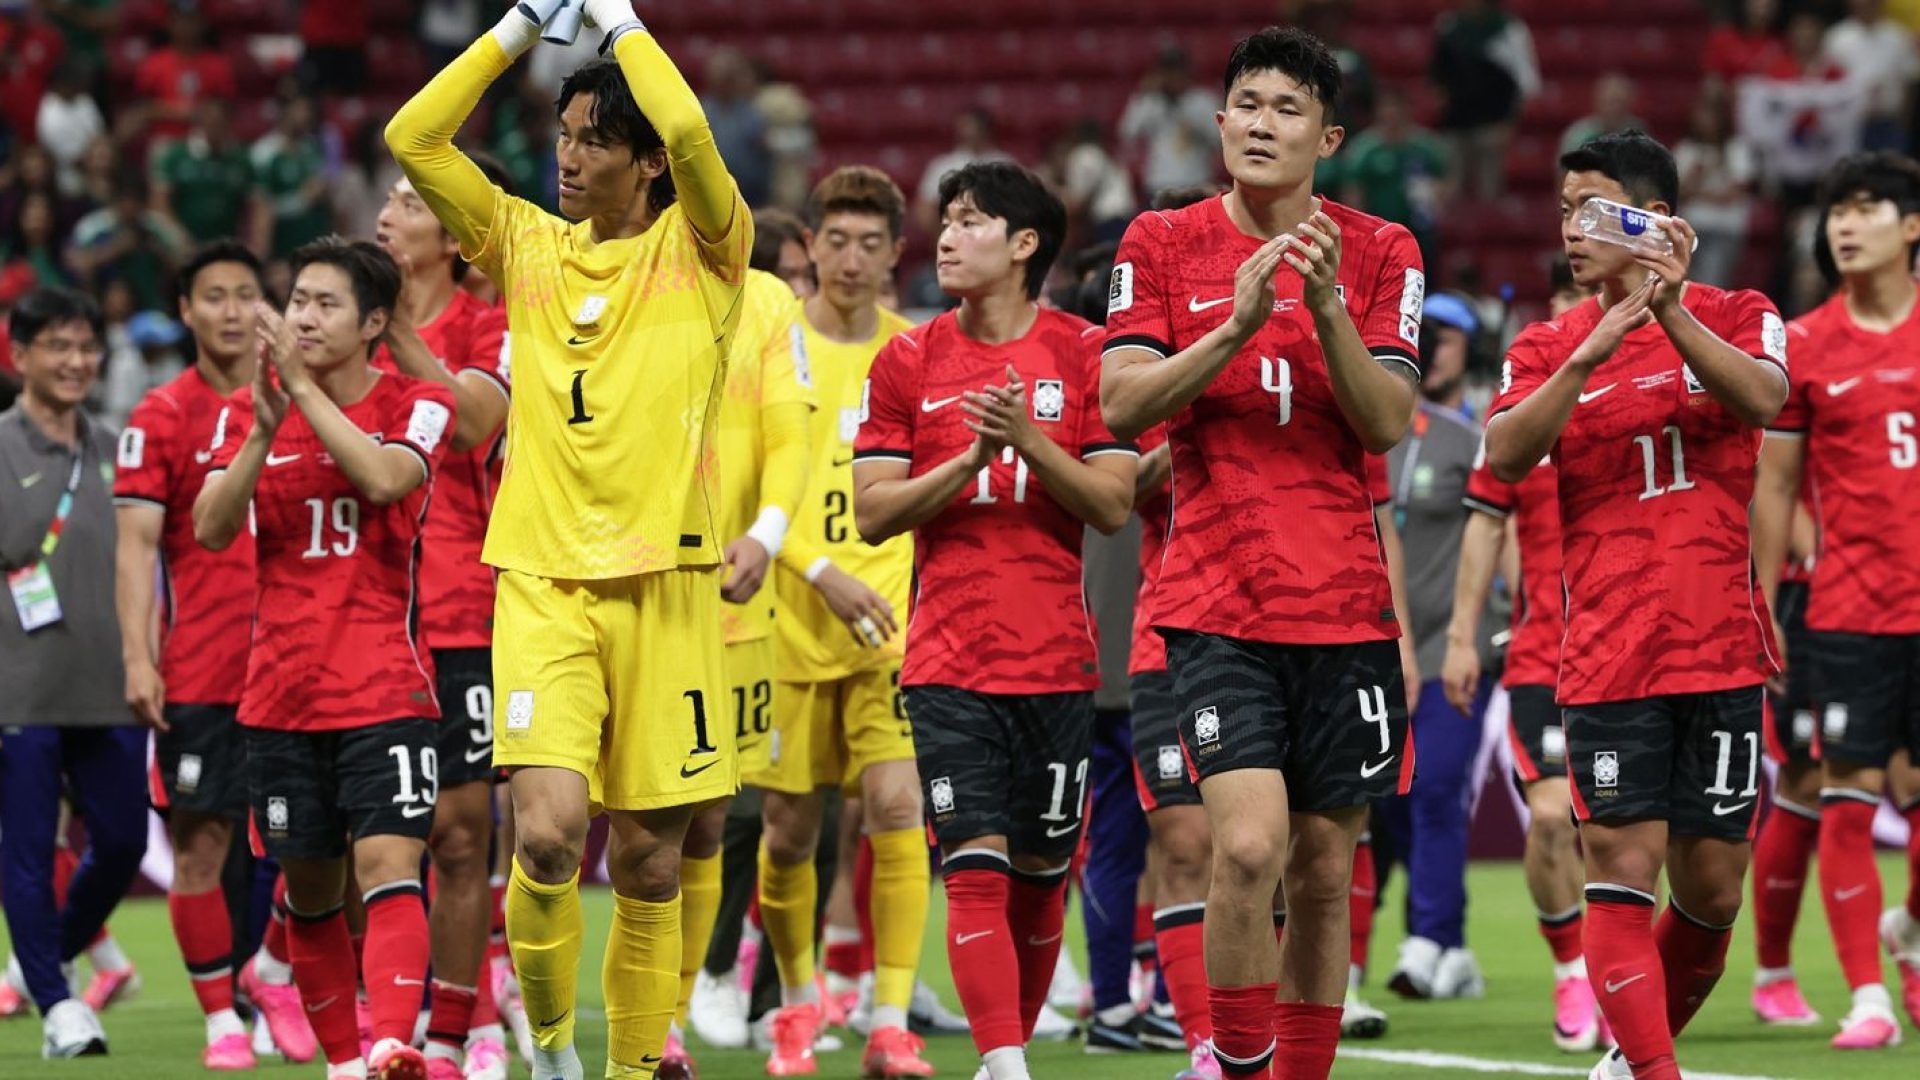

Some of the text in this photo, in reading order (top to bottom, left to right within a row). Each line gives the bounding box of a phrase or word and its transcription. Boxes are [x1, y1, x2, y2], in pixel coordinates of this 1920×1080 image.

[567, 369, 594, 426] 1
[1260, 355, 1293, 426] 4
[1633, 425, 1696, 502] 11
[1886, 410, 1918, 470] 5
[302, 497, 359, 558] 19
[465, 684, 493, 744] 9
[683, 689, 717, 757] 1
[732, 679, 771, 739] 12
[1356, 685, 1391, 754] 4
[388, 744, 439, 806] 19
[1704, 729, 1758, 798] 11
